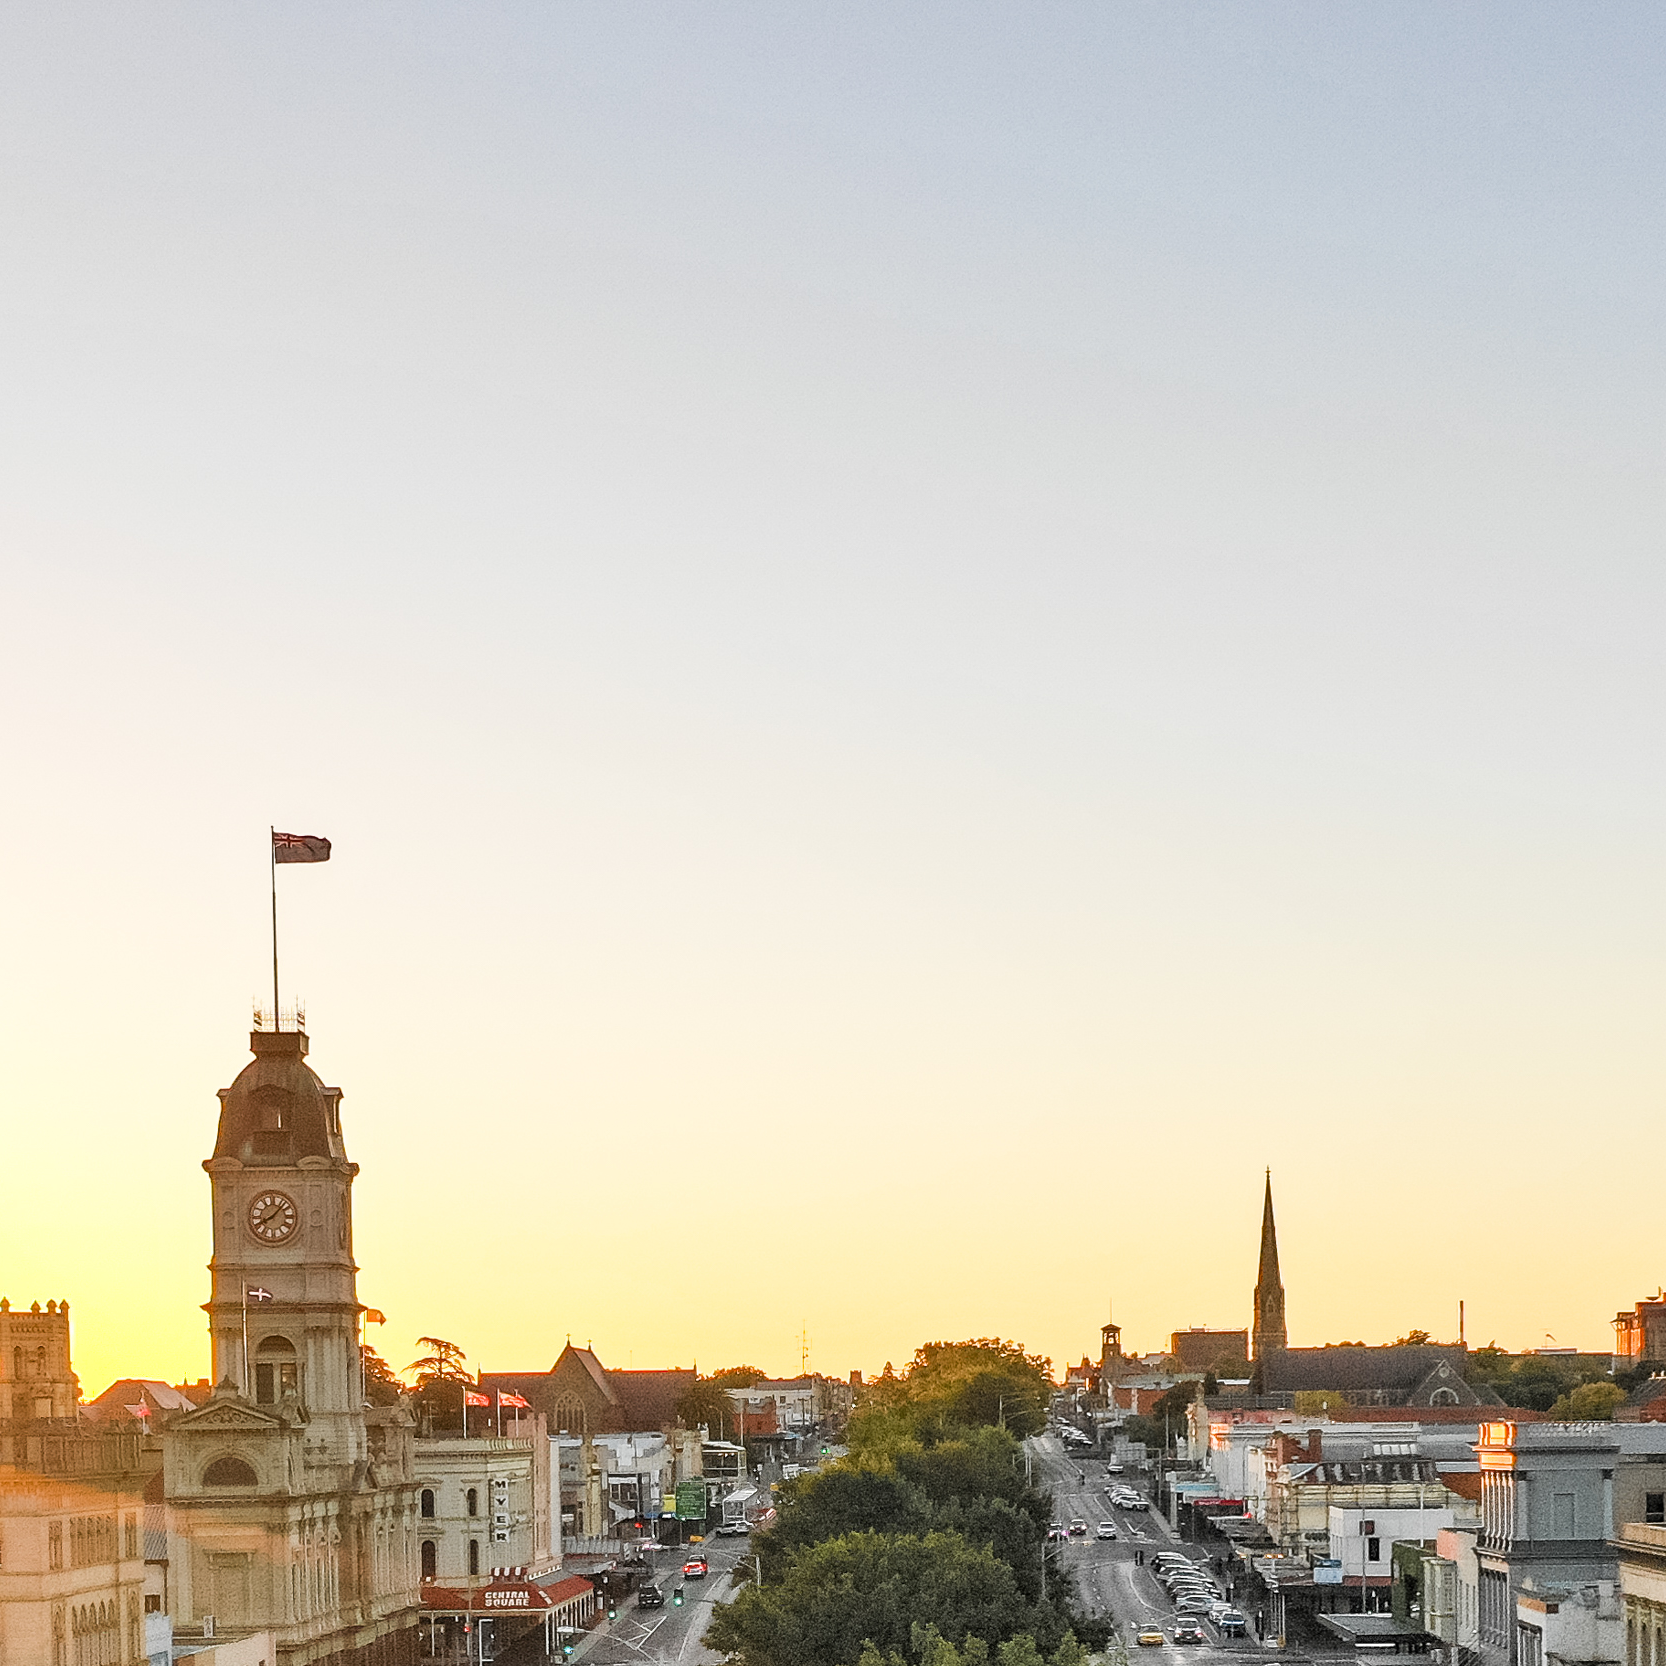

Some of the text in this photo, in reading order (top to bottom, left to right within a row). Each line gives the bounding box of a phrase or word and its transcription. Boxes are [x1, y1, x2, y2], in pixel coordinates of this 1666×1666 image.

[494, 1480, 507, 1540] MYER
[485, 1591, 530, 1599] CENTRAL
[485, 1599, 529, 1608] SQUARE
